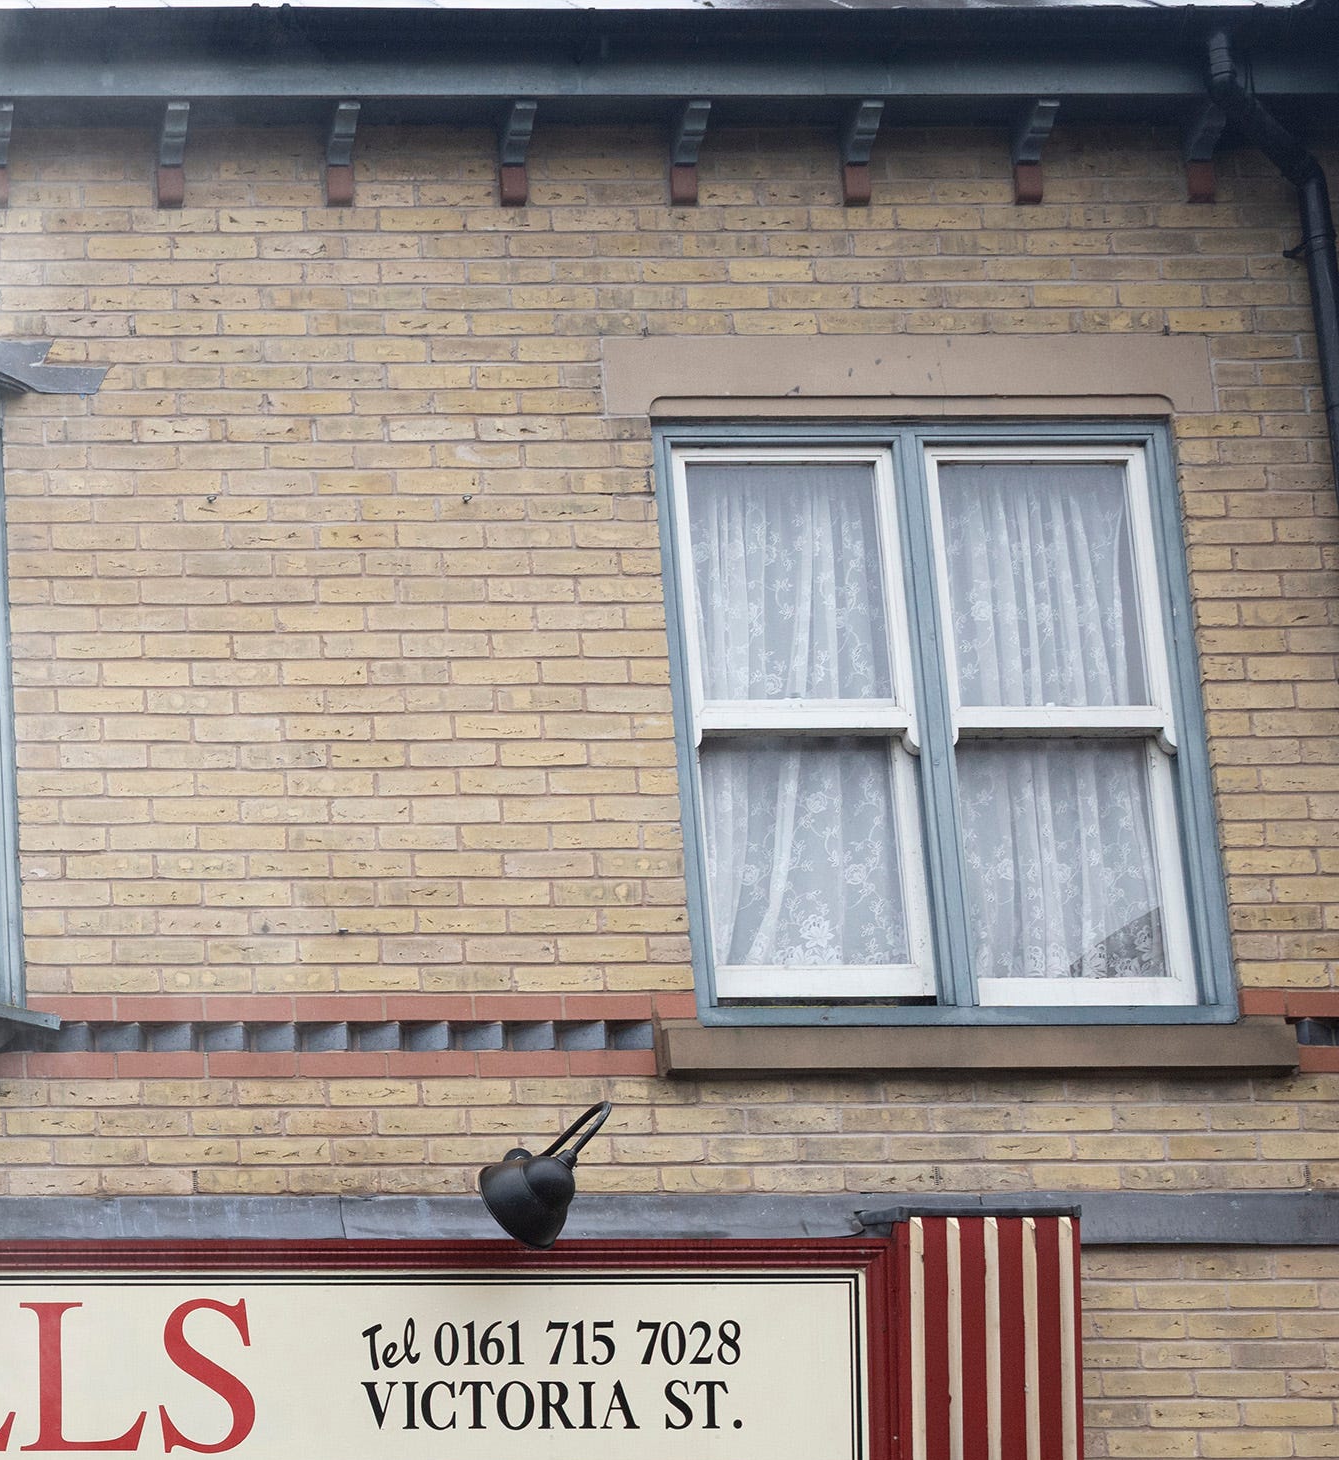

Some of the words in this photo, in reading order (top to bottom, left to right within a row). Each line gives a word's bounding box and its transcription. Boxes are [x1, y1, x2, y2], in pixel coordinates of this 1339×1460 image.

[361, 1317, 421, 1371] Tel
[433, 1319, 525, 1367] 0161
[545, 1319, 616, 1367] 715
[636, 1319, 742, 1366] 7028
[361, 1379, 641, 1431] VICTORIA
[664, 1379, 744, 1430] ST.
